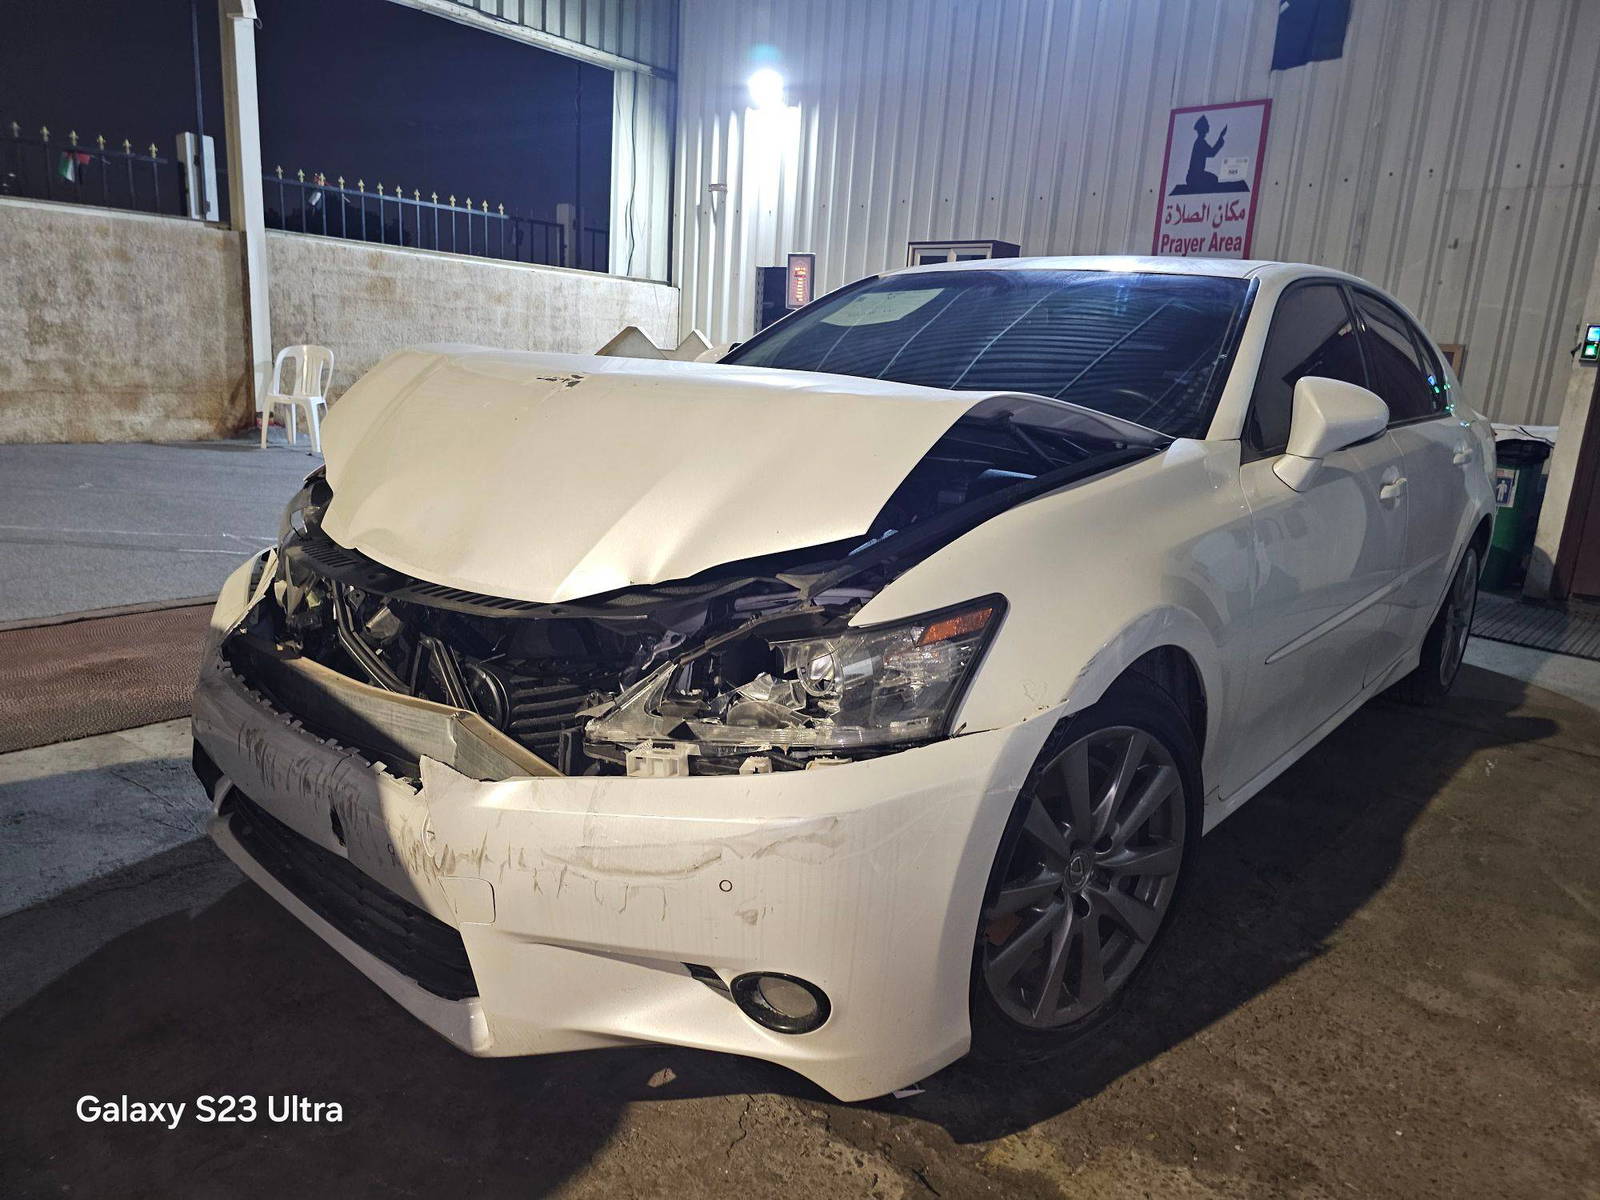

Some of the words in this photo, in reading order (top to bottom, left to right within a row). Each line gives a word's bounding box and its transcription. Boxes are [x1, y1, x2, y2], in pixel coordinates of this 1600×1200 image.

[1164, 202, 1211, 225] الصلاة
[1211, 199, 1246, 228] مكان
[1160, 233, 1206, 257] Prayer
[1208, 231, 1243, 252] Area
